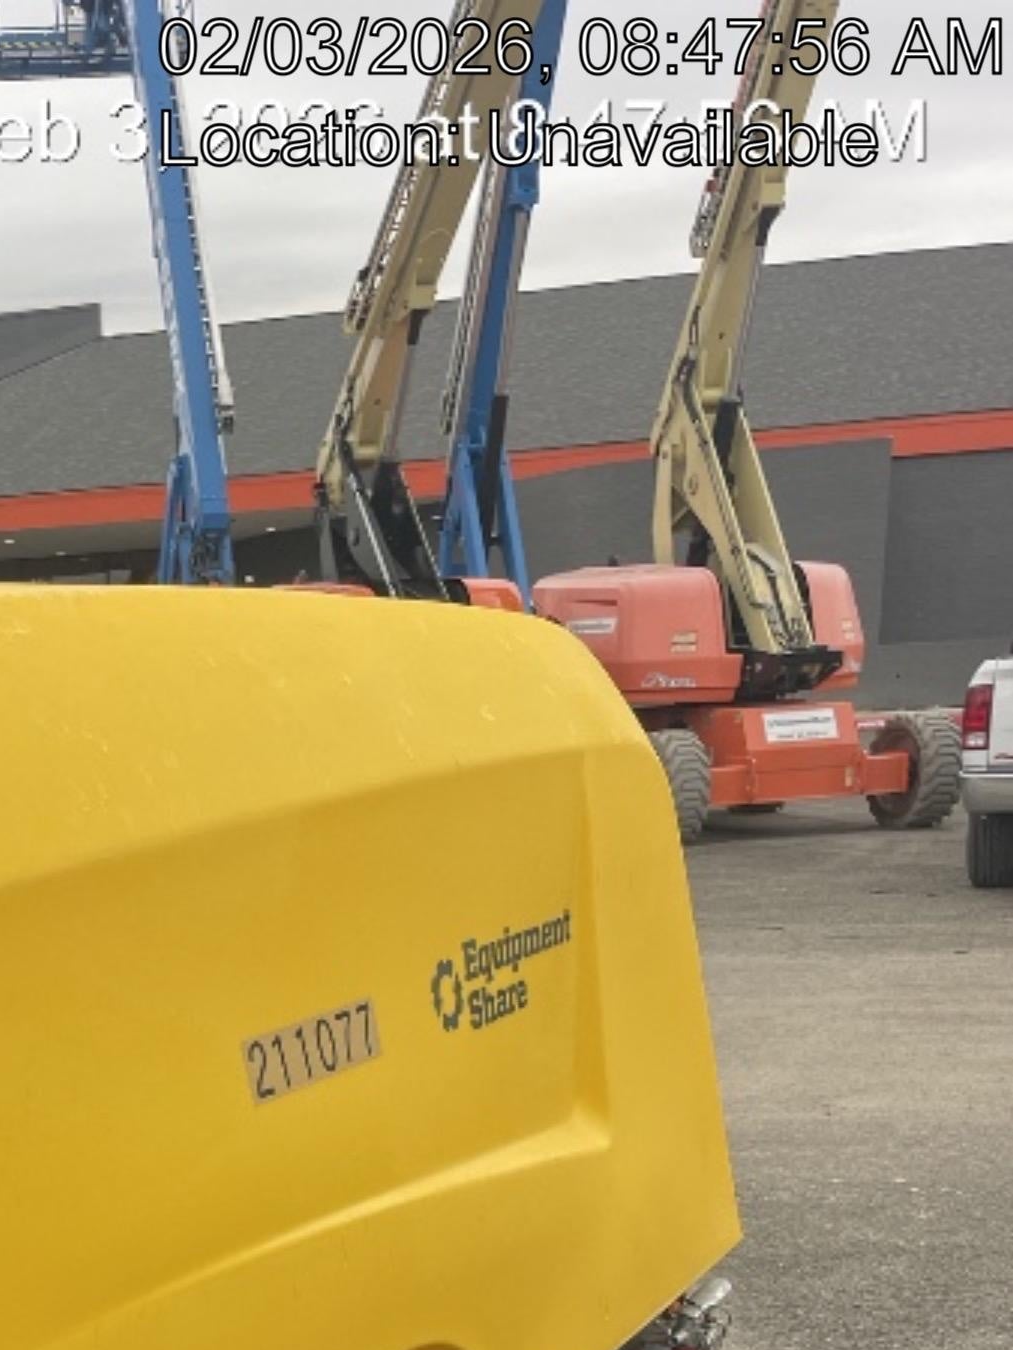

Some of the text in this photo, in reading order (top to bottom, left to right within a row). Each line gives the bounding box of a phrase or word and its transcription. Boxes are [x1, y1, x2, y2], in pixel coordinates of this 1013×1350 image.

[461, 909, 570, 984] Equipment
[468, 980, 528, 1029] Share
[248, 1002, 372, 1098] 211077
